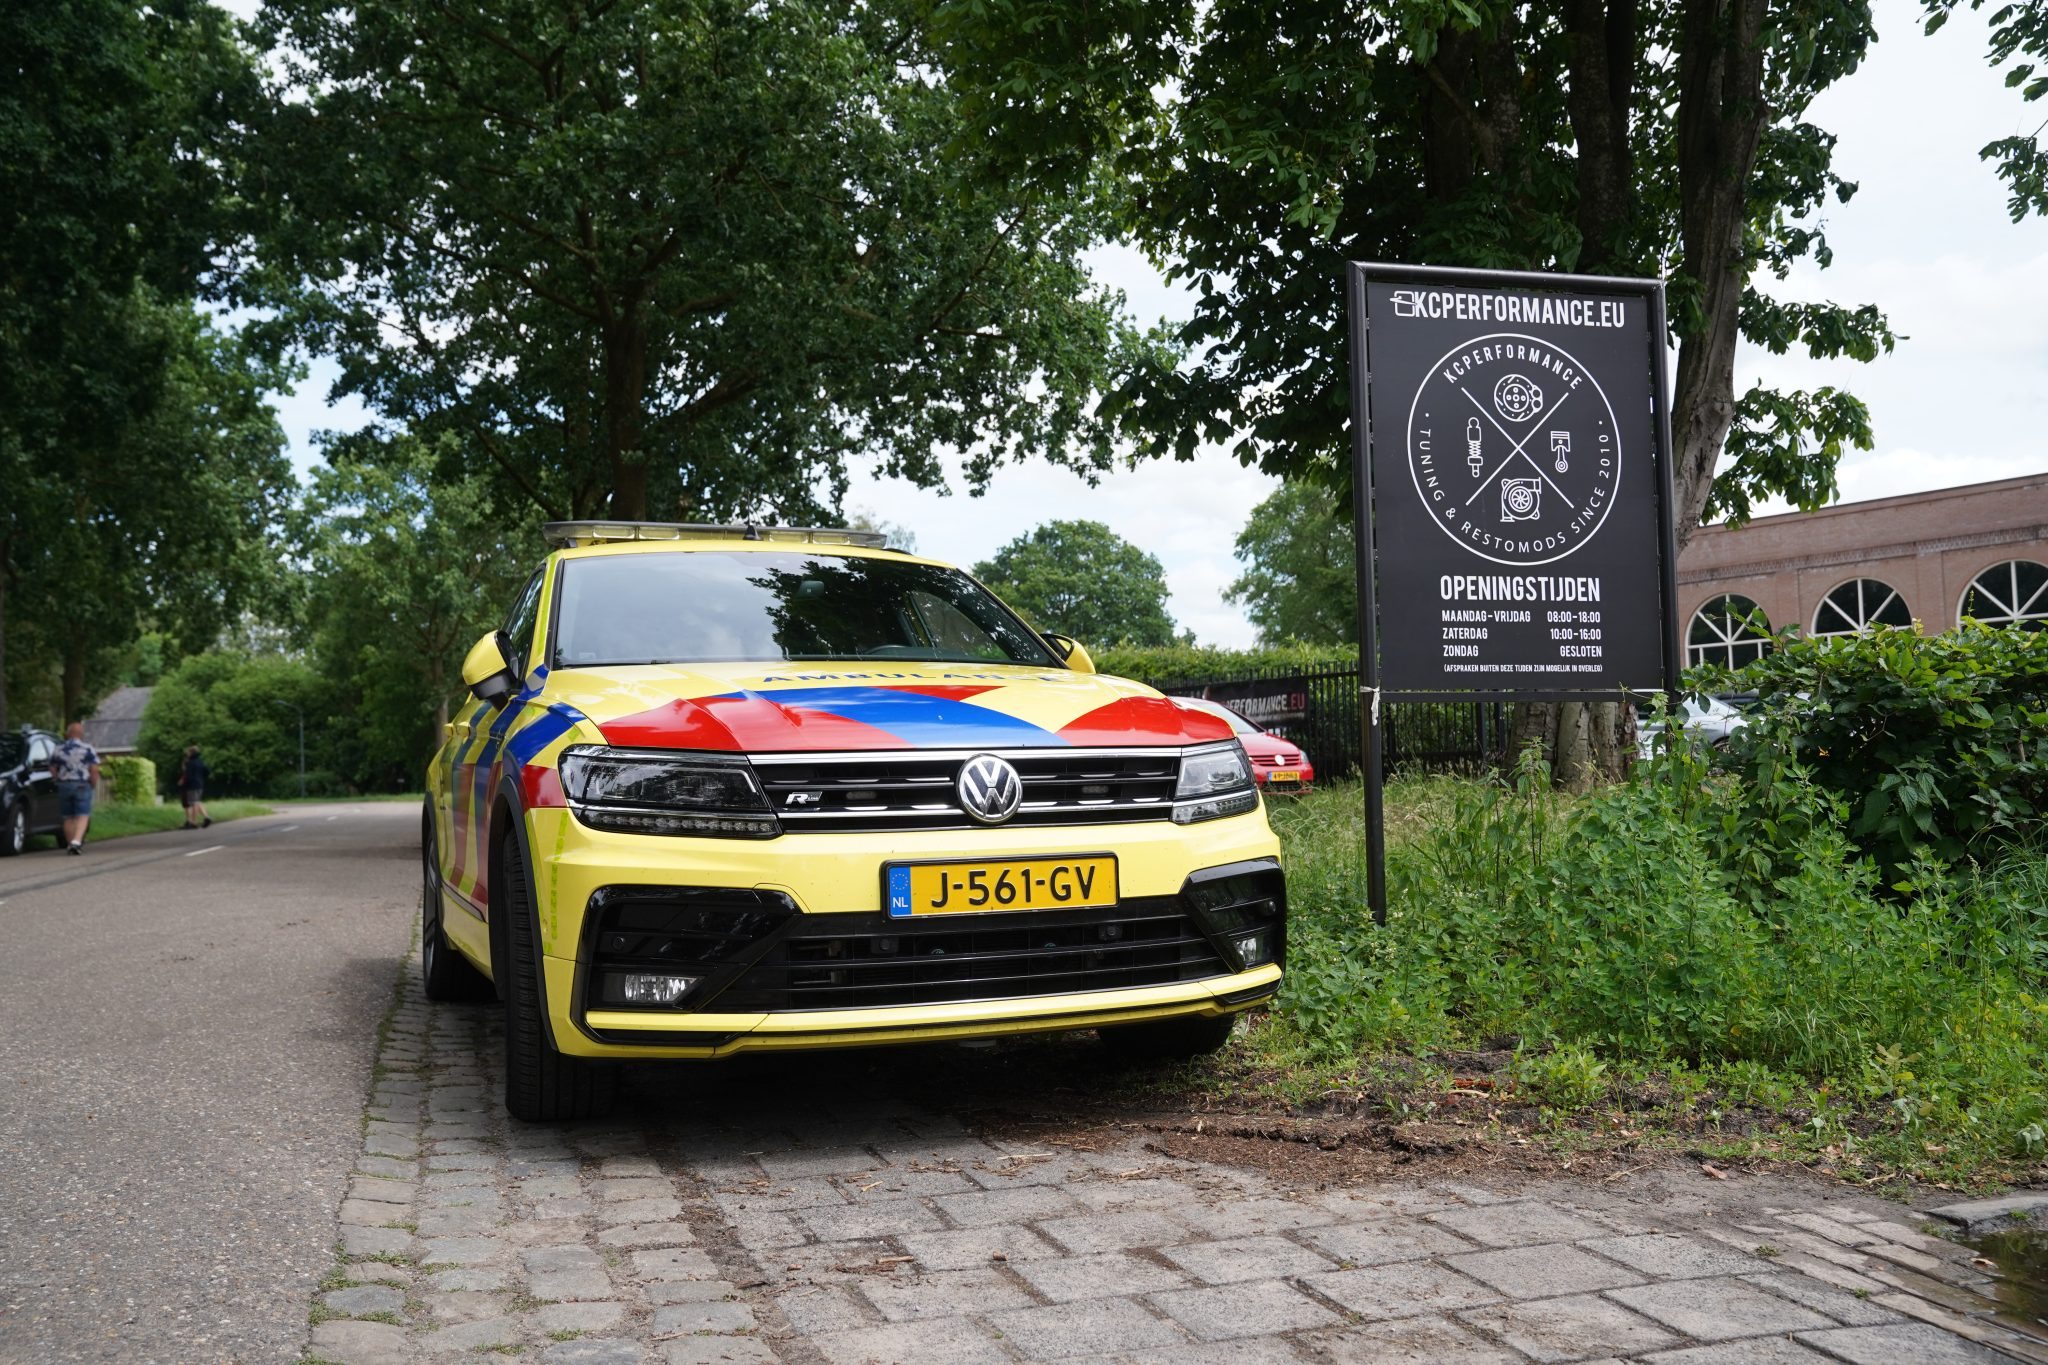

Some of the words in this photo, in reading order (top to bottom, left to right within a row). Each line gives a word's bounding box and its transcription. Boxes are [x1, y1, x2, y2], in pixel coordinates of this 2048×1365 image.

[1414, 291, 1625, 328] KCPERFORMANCE.EU
[1443, 344, 1582, 390] KCPERFORMANCE
[1419, 428, 1445, 501] TUNING
[1445, 507, 1456, 519] &
[1461, 520, 1566, 553] RESTOMODS
[1570, 486, 1605, 534] SINCE
[1598, 434, 1610, 479] 2010
[1440, 575, 1601, 602] OPENINGSTIJDEN
[1442, 627, 1488, 640] ZATERDAG
[1443, 645, 1479, 657] ZONDAG
[1560, 645, 1602, 657] GESLOTEN
[1500, 664, 1514, 673] DEZE
[931, 865, 1096, 909] J-561-GV
[892, 896, 909, 909] NL
